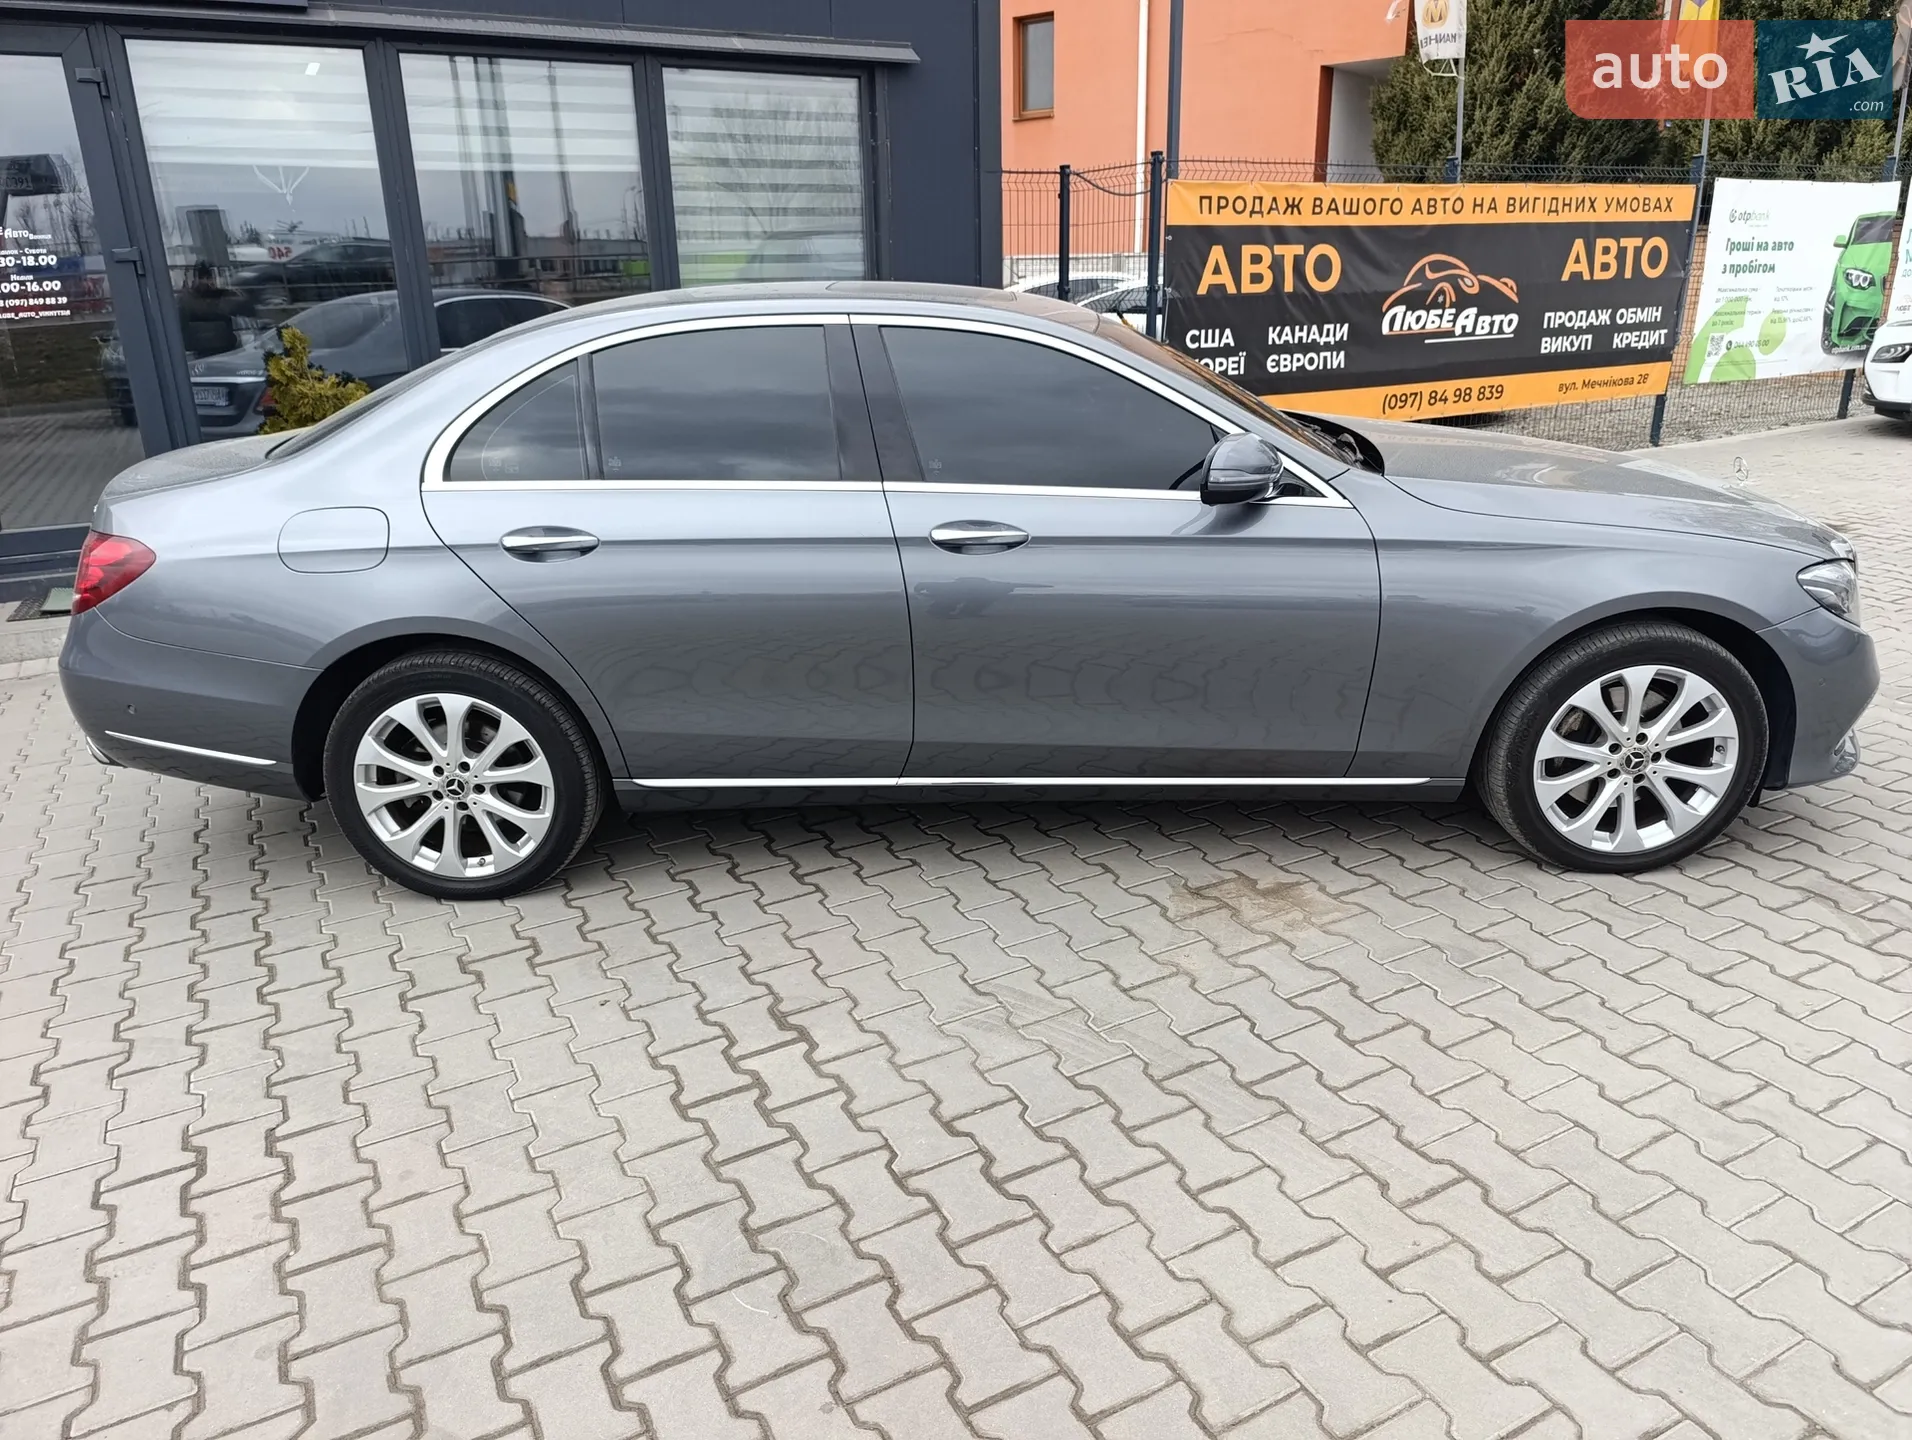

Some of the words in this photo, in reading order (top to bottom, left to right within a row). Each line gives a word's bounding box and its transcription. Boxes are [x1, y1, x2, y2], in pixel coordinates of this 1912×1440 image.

[1198, 195, 1304, 218] ПРОДАЖ
[1311, 196, 1404, 216] ВАШОГО
[1410, 196, 1464, 215] АВТО
[1472, 196, 1498, 214] НА
[1505, 196, 1598, 217] ВИГІДНИХ
[1604, 196, 1674, 214] УМОВАХ
[1560, 236, 1669, 282] АВТО
[1725, 236, 1755, 256] Гроші
[1756, 240, 1769, 251] на
[1771, 240, 1795, 251] авто
[1196, 243, 1343, 296] АВТО
[1721, 263, 1727, 275] з
[1729, 258, 1776, 278] пробігом
[1542, 308, 1613, 331] ПРОДАЖ
[1615, 305, 1663, 325] ОБМІН
[1185, 327, 1236, 349] США
[1267, 322, 1349, 346] КАНАДИ
[1540, 333, 1593, 355] ВИКУП
[1612, 328, 1669, 350] КРЕДИТ
[1193, 351, 1247, 376] ОРЕЇ
[1266, 350, 1346, 374] ЄВРОПИ
[1557, 382, 1578, 395] вул.
[1581, 375, 1634, 390] Мечнікова
[1637, 372, 1650, 385] 28
[1382, 390, 1423, 415] (097)
[1428, 389, 1449, 406] 84
[1452, 387, 1473, 403] 98
[1477, 384, 1504, 401] 839
